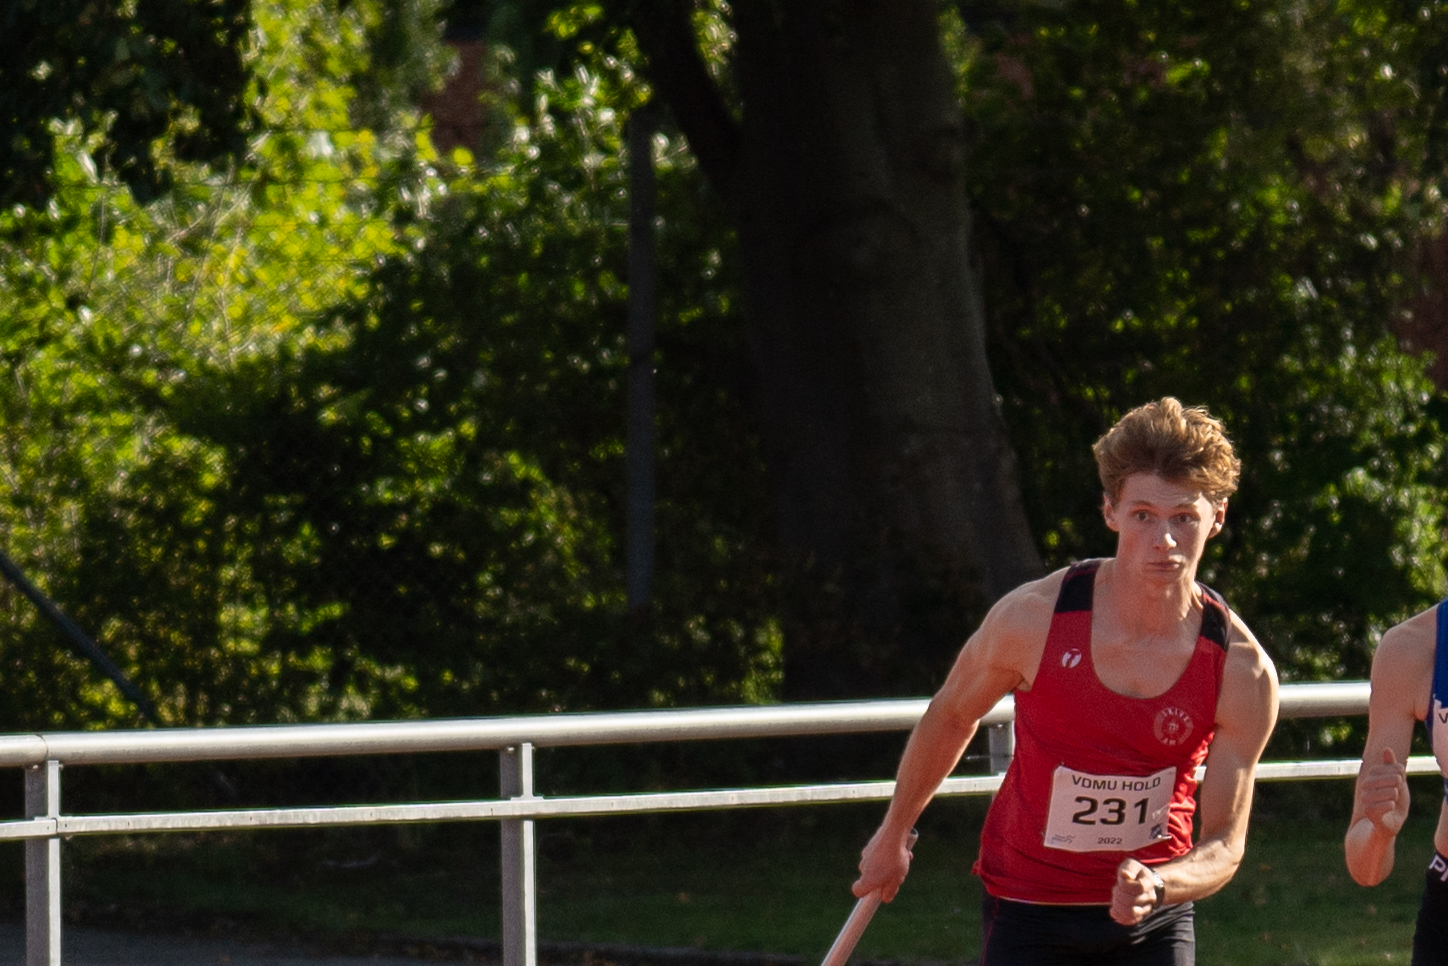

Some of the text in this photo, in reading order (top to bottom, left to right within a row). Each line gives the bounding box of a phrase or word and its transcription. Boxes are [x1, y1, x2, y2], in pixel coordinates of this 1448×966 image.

[1071, 774, 1161, 791] VDMU HOLD
[1072, 796, 1150, 825] 231
[1097, 837, 1122, 845] 2022
